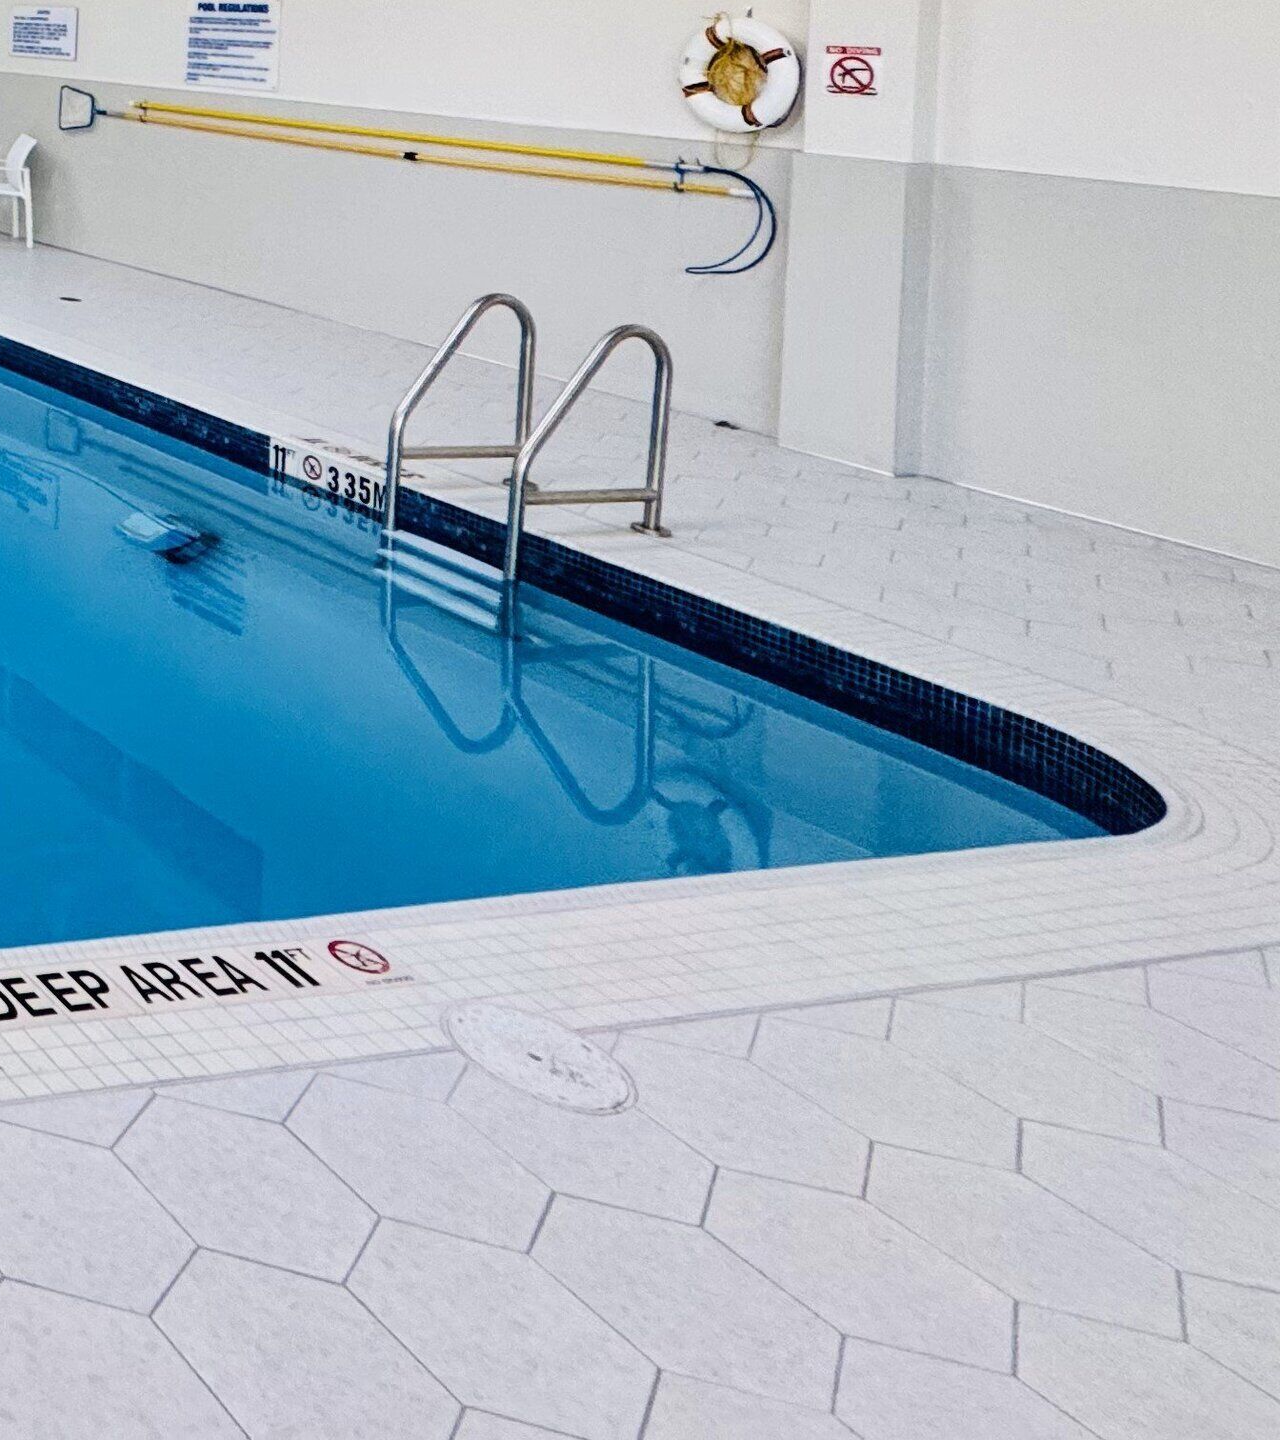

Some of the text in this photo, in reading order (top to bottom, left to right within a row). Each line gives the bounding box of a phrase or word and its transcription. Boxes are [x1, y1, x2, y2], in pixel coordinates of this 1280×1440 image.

[198, 3, 269, 13] POOL REGULATIONS
[120, 955, 269, 1004] AREA
